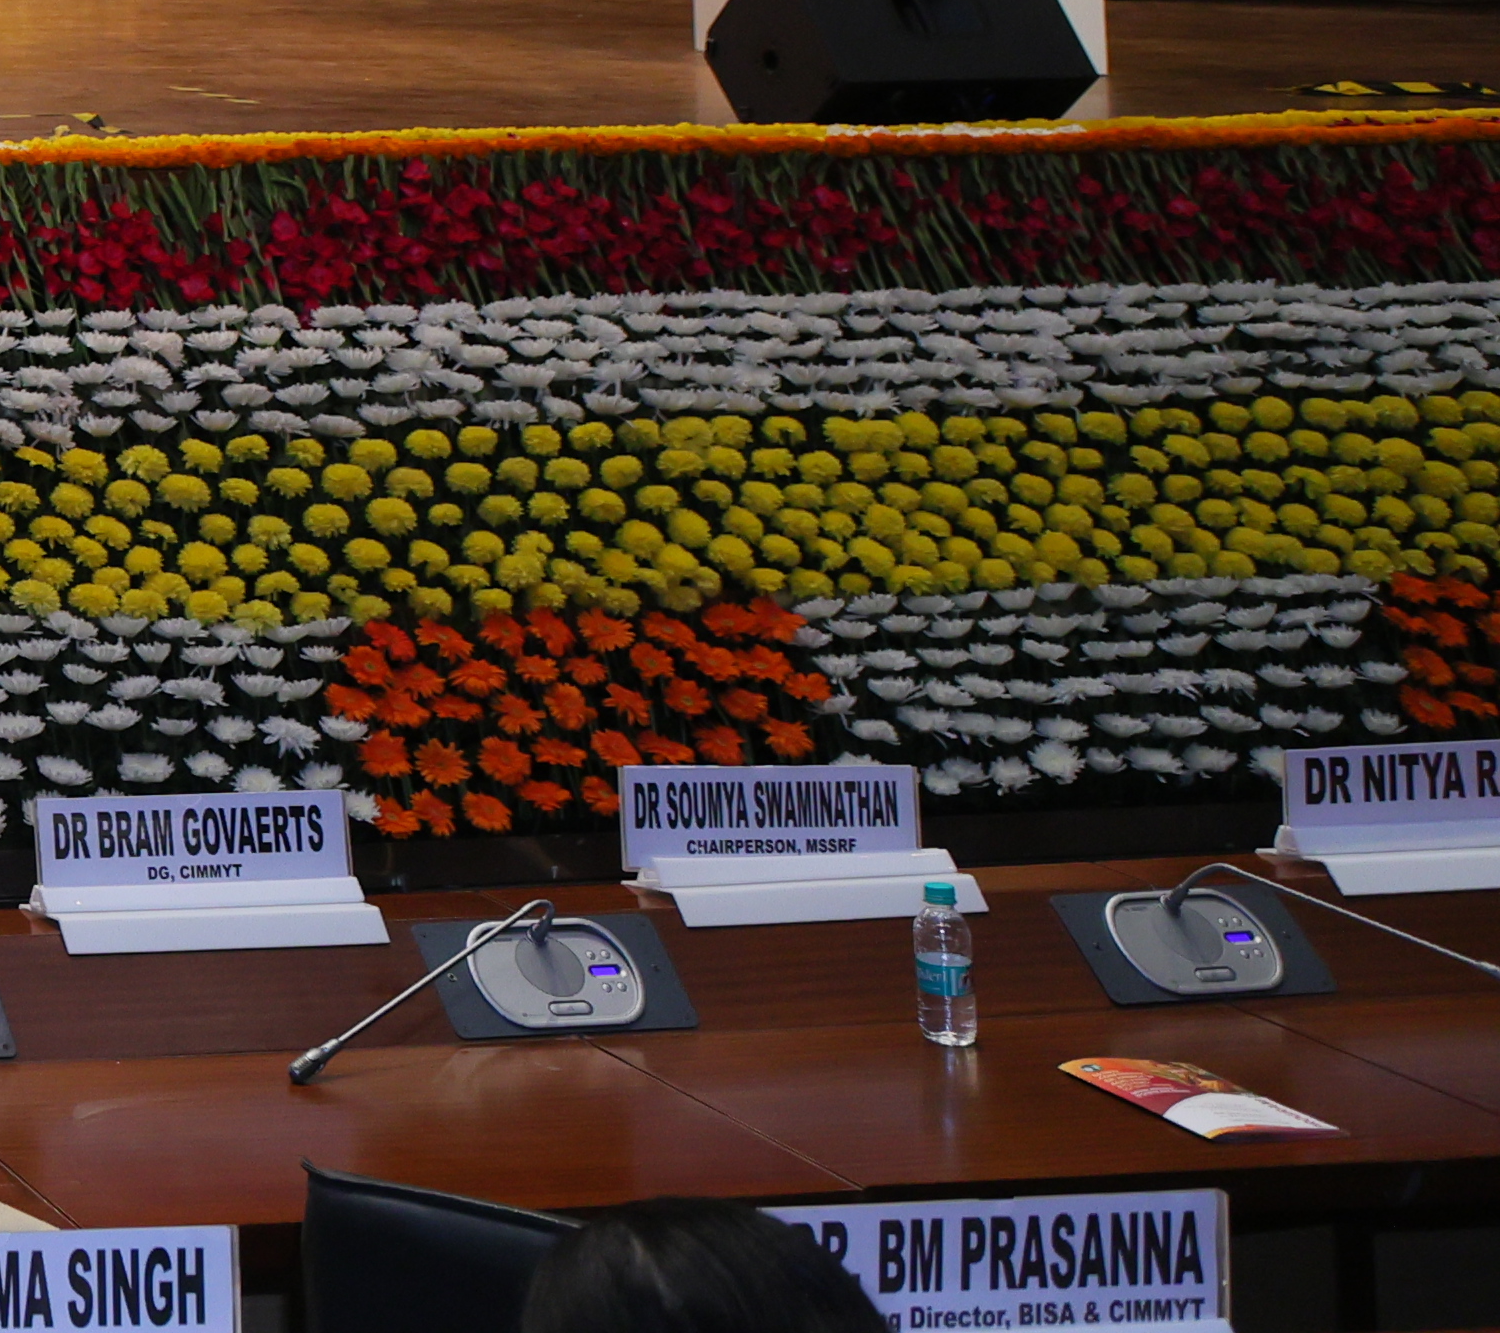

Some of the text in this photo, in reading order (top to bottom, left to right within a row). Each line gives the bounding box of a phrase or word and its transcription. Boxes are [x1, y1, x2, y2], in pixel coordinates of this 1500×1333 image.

[1305, 757, 1351, 804] DR
[1362, 752, 1465, 802] NITYA
[634, 781, 898, 829] DR SOUMYA SWAMINATHAN
[53, 805, 323, 859] DR BRAM GOVAERTS
[687, 839, 857, 855] CHAIRPERSON, MSSRF
[148, 864, 242, 882] DG, CIMMYT
[879, 1218, 944, 1294] BM
[960, 1210, 1204, 1291] PRASANNA
[68, 1247, 206, 1328] SINGH
[910, 1305, 1011, 1331] Director,
[1018, 1303, 1076, 1326] BISA
[1084, 1303, 1100, 1323] &
[1109, 1298, 1204, 1323] CIMMYT
